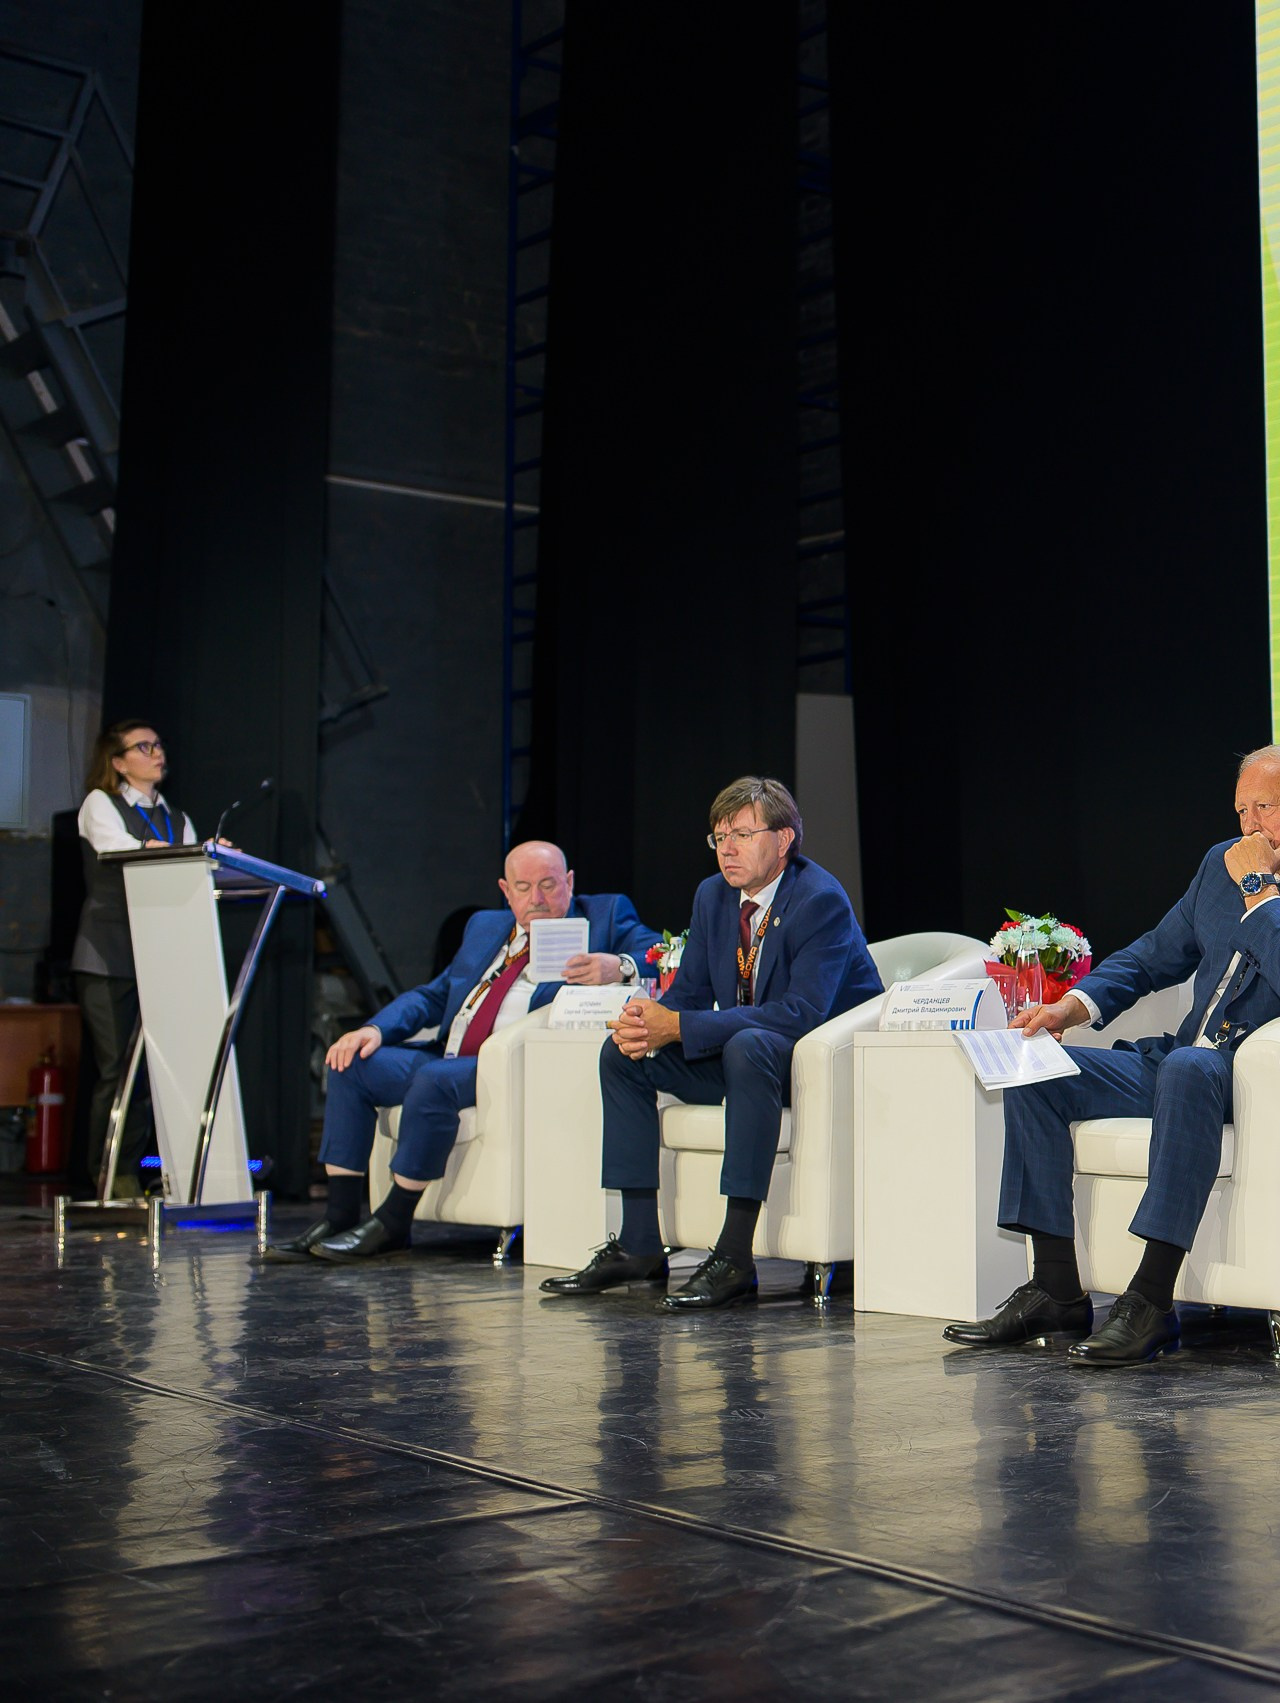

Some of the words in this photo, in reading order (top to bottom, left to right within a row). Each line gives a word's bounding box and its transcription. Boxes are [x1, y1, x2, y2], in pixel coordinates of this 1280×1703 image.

[913, 997, 951, 1006] ЧЕРДАНЦЕВ
[892, 1007, 919, 1015] Дмитрий
[921, 1006, 967, 1014] Владимирович
